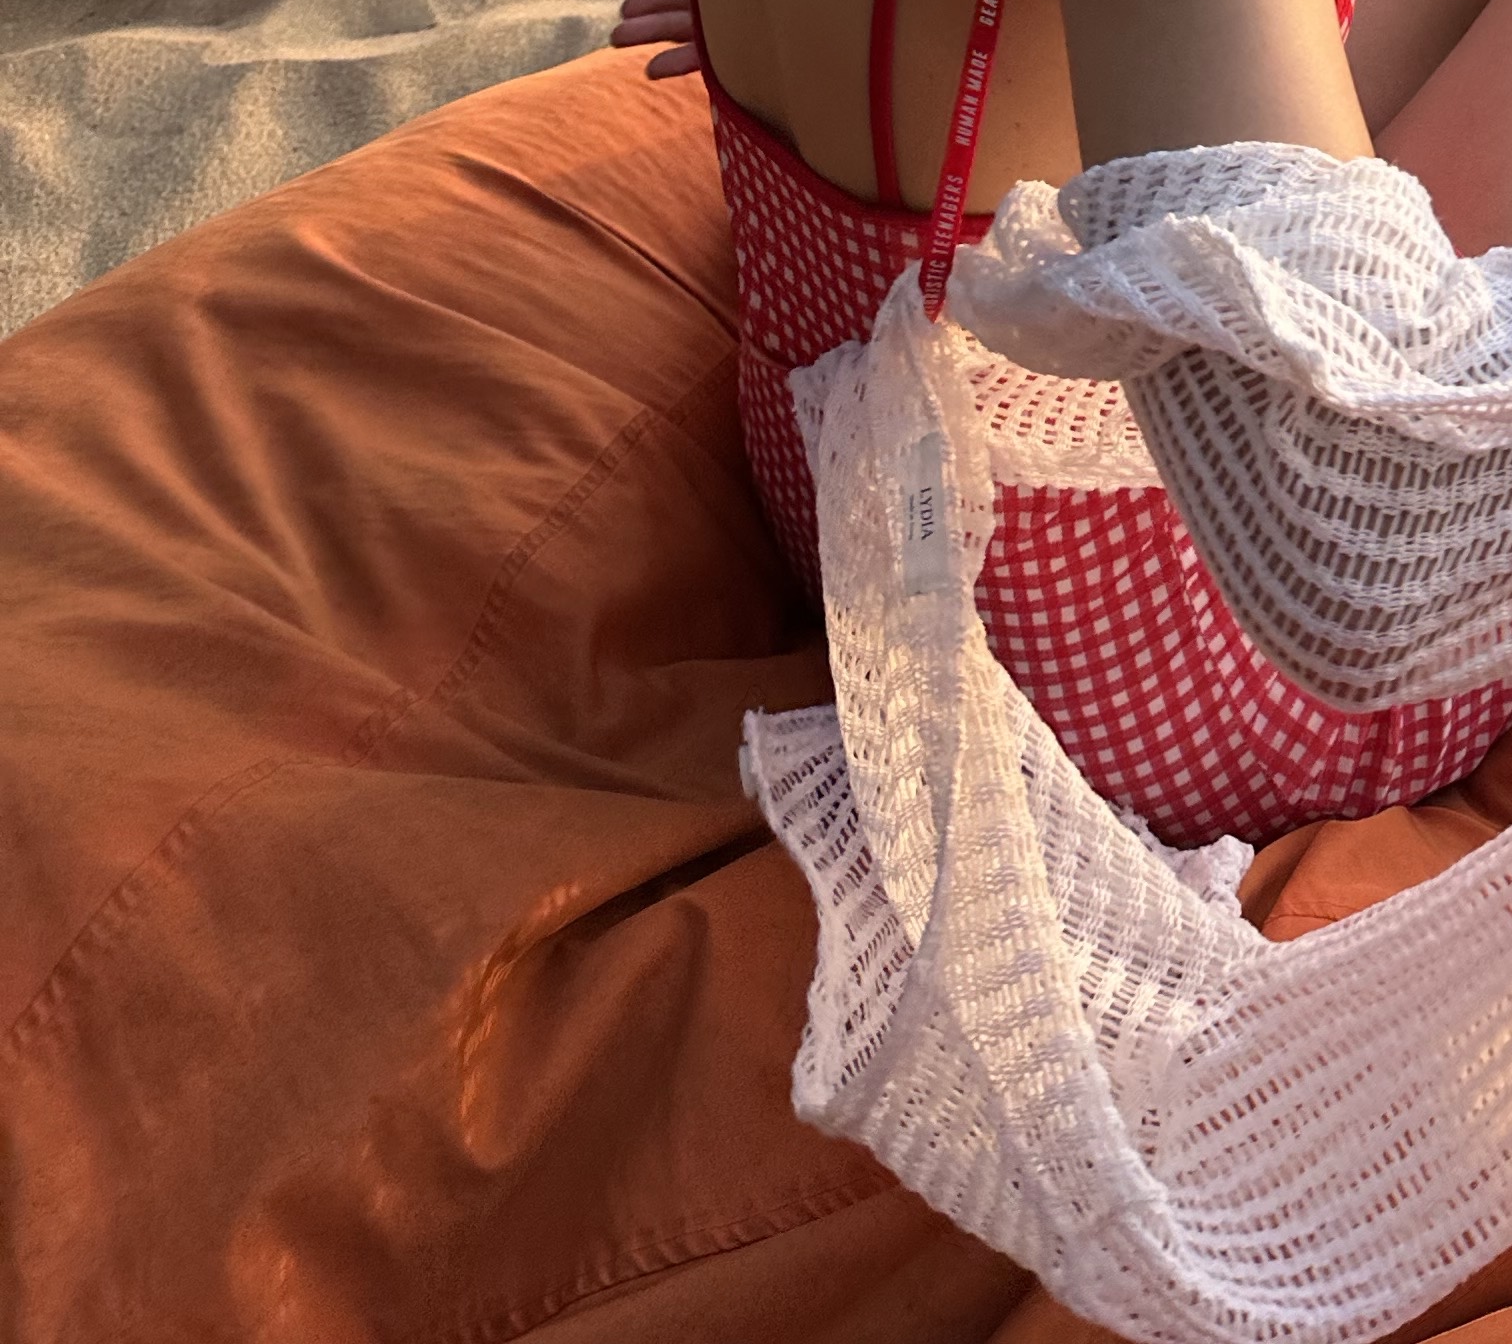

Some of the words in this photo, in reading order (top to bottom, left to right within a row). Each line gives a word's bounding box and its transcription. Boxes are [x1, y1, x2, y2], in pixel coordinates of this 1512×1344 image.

[965, 49, 988, 92] MADE
[954, 94, 980, 146] HUMAN
[930, 174, 965, 255] TEENAGERS
[920, 487, 934, 540] LYDIA
